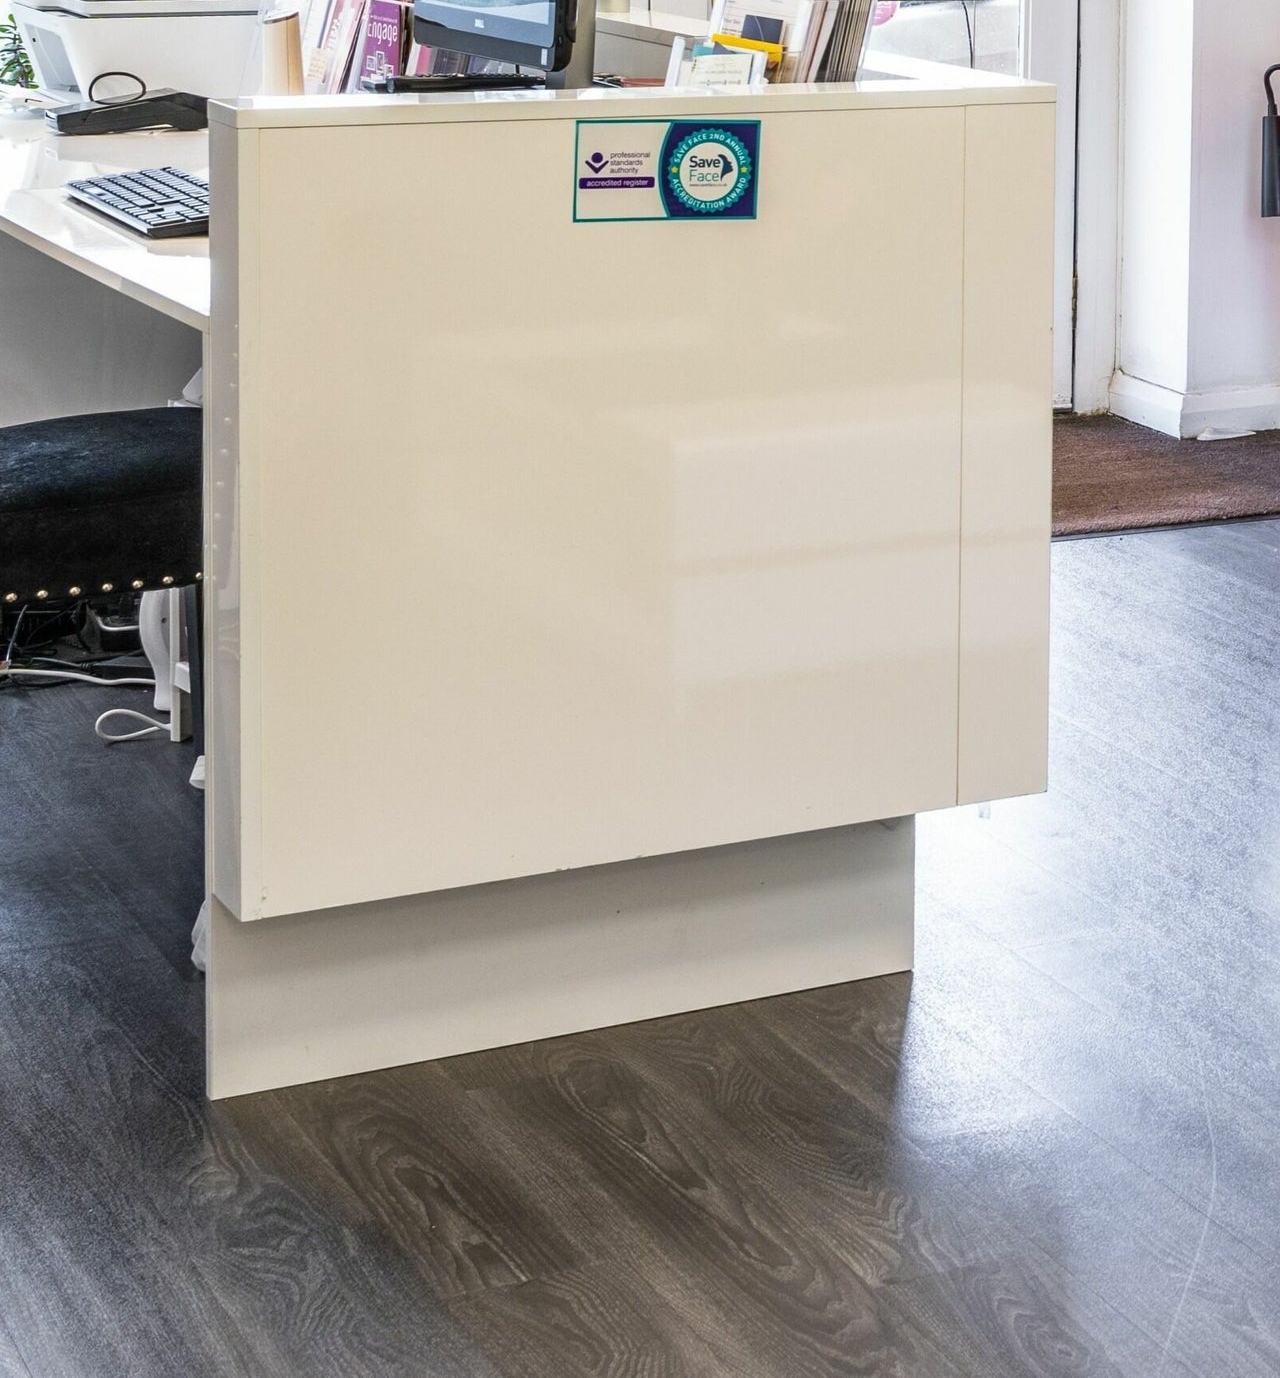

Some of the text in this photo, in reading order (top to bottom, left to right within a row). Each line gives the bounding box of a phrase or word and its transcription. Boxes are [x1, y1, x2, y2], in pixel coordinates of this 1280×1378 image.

[367, 21, 398, 47] Engage
[610, 150, 651, 160] professional
[674, 133, 747, 165] SAVE FACE 2ND ANNUAL
[609, 159, 644, 167] standards
[689, 155, 721, 168] Save
[609, 167, 639, 175] authority
[689, 168, 720, 182] Face
[586, 178, 649, 188] accredited register
[672, 177, 747, 209] ACCREDITATION AWARD
